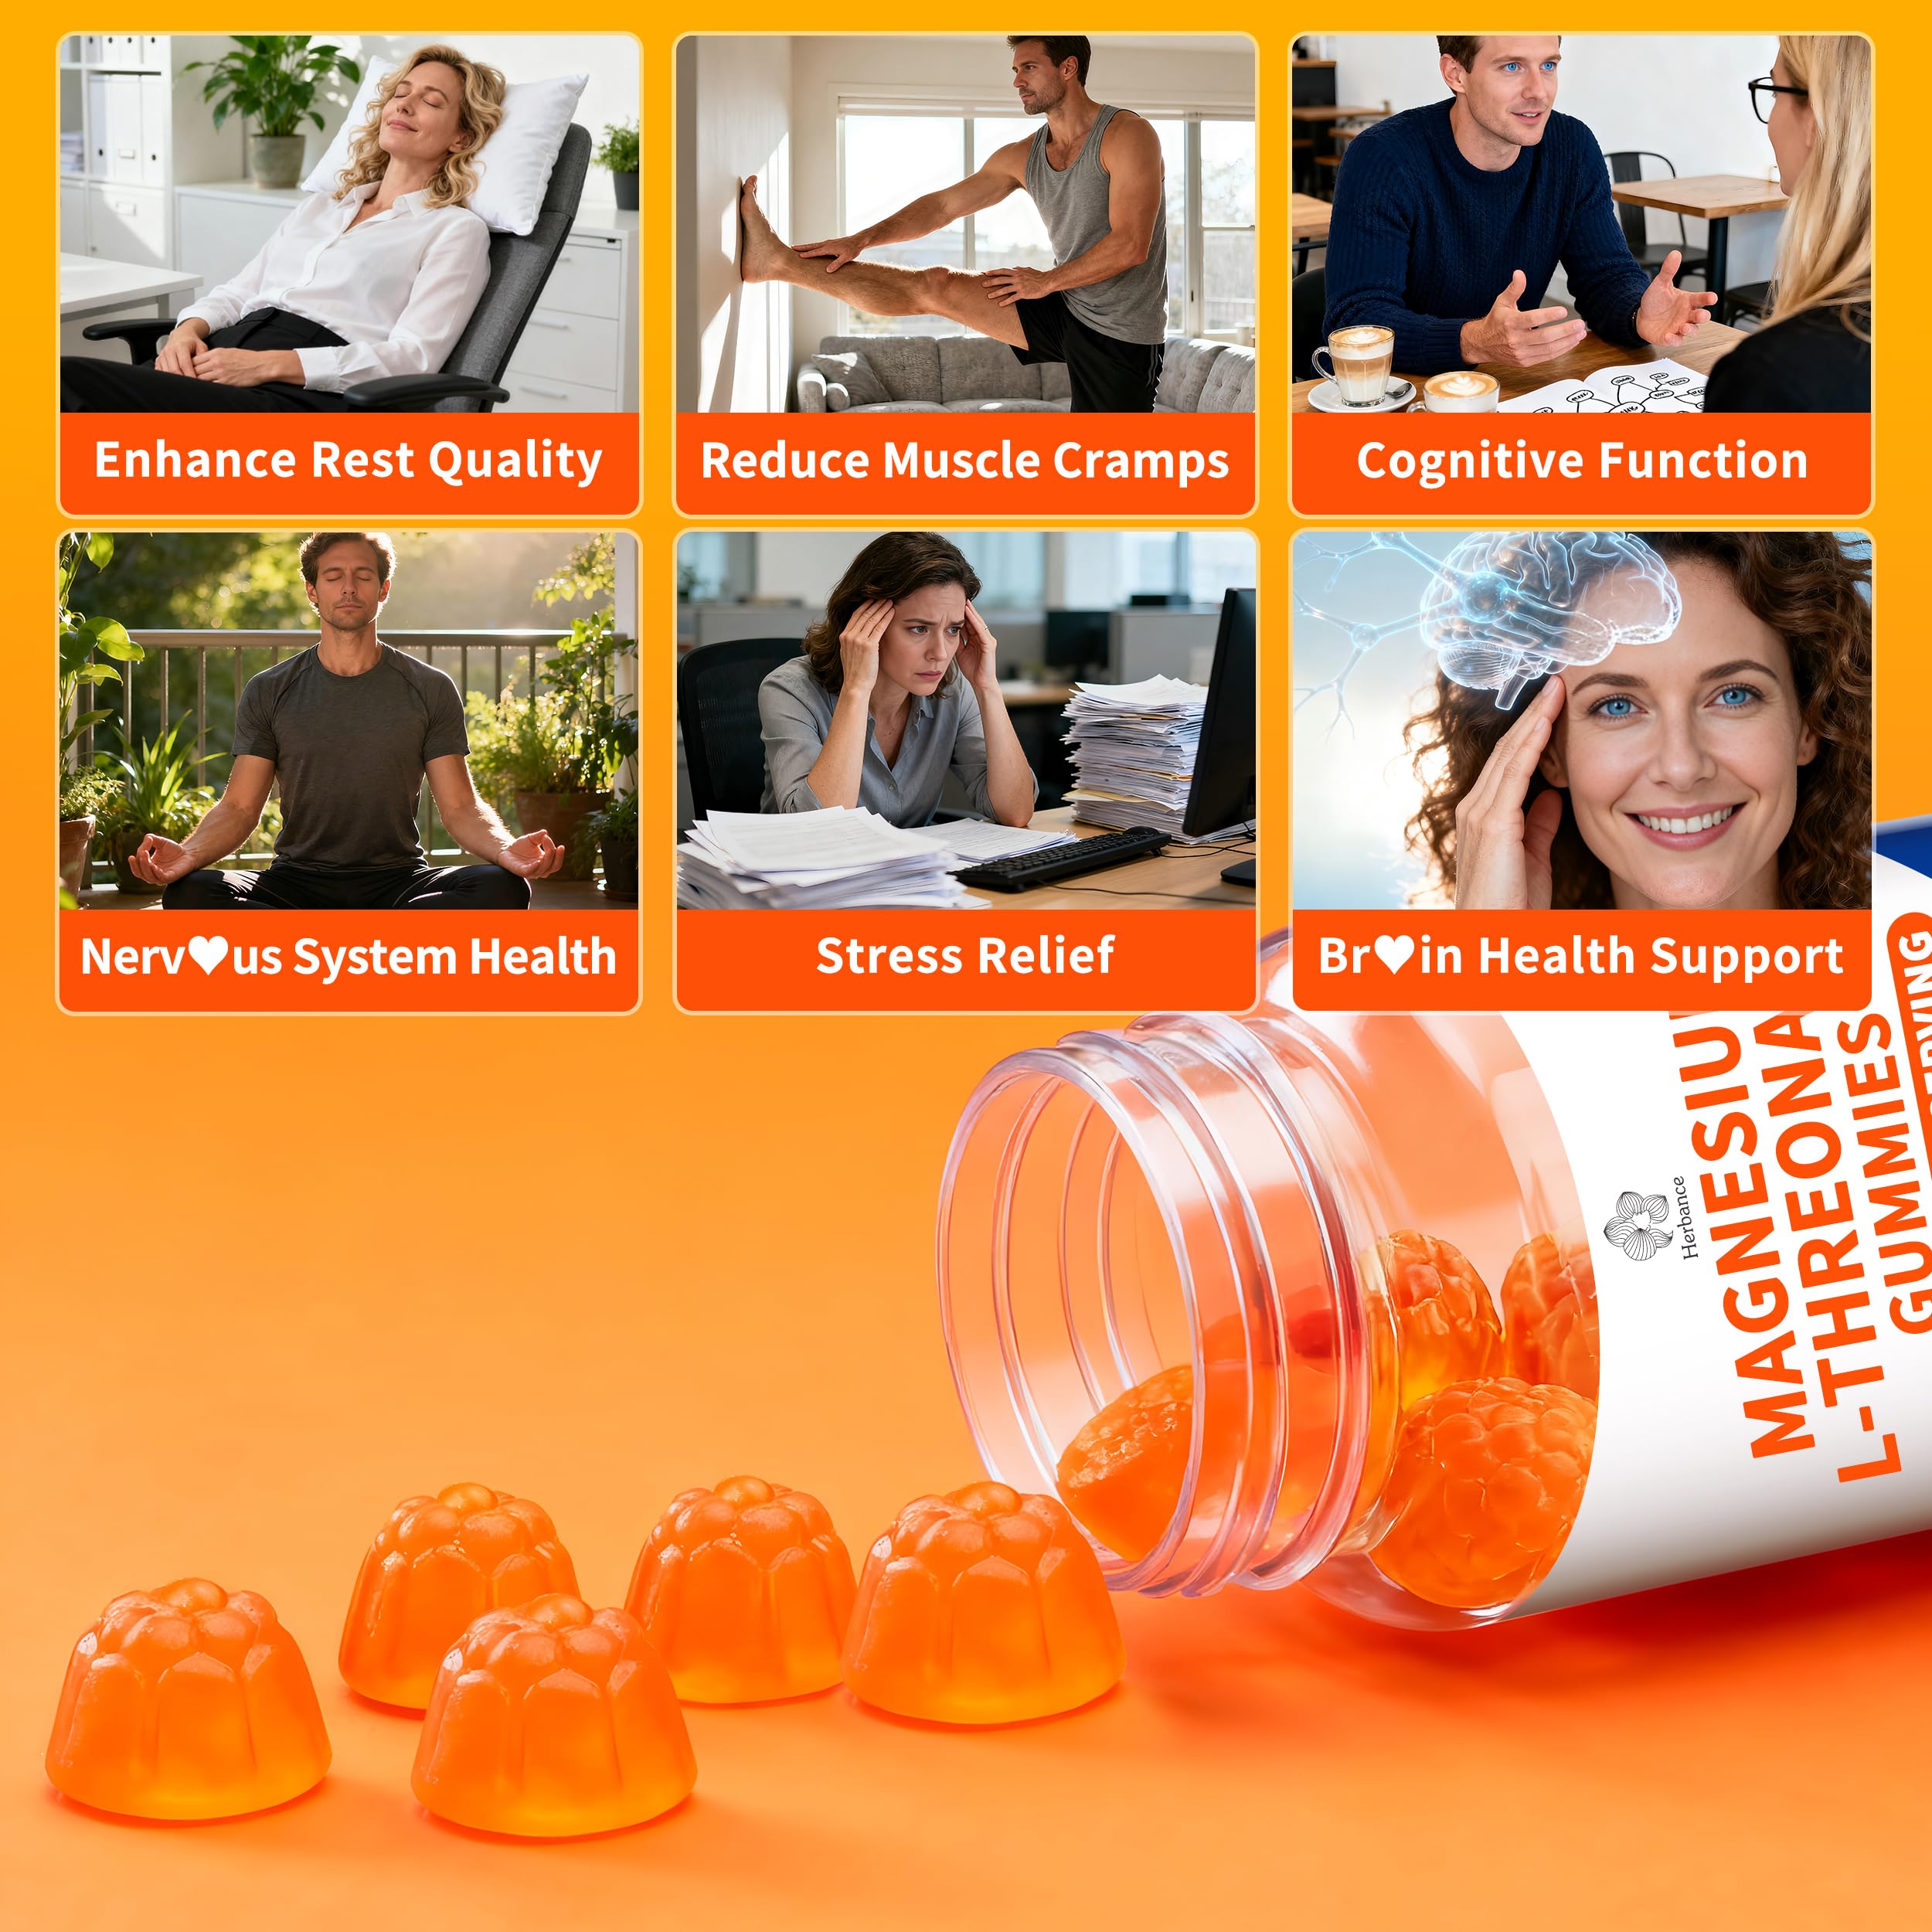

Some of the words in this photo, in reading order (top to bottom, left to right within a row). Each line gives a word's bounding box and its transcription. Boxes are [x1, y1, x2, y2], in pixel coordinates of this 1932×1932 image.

[1668, 1011, 1815, 1459] MAGNESIU
[1673, 1175, 1699, 1260] Herbance
[1837, 1013, 1932, 1335] GUMMIES
